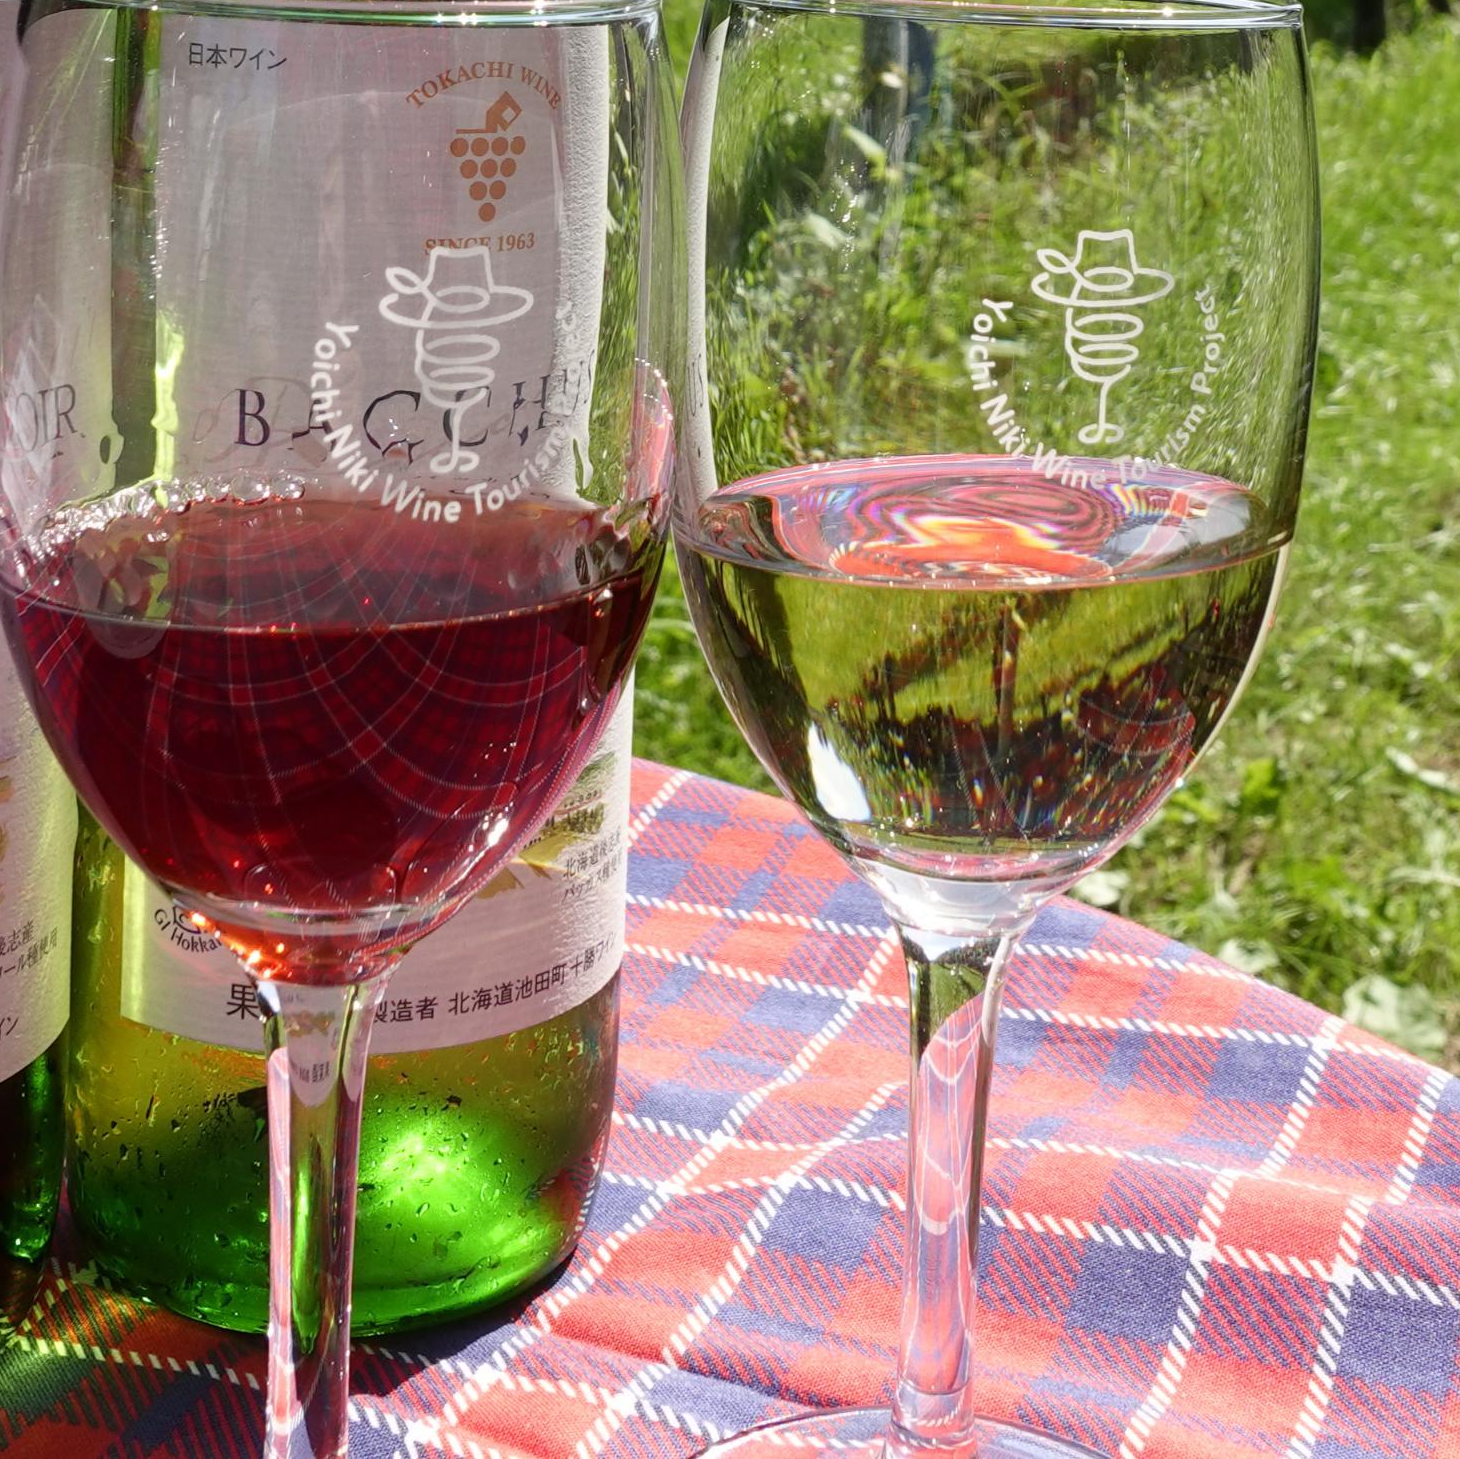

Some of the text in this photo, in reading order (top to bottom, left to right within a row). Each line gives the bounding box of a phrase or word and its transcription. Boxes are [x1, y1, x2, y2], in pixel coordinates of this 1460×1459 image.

[187, 42, 287, 71] 日本ワイン
[406, 61, 561, 110] TOKACHI WINE
[497, 232, 534, 252] 1963
[310, 321, 359, 422] Yoichi
[970, 284, 1226, 490] Yoichi Niki Wine Tourism Project
[323, 423, 379, 492] Niki
[465, 419, 570, 515] Tourism
[380, 474, 461, 523] Wine
[170, 927, 222, 953] Hokkai
[448, 963, 567, 1016] 北海道池田町
